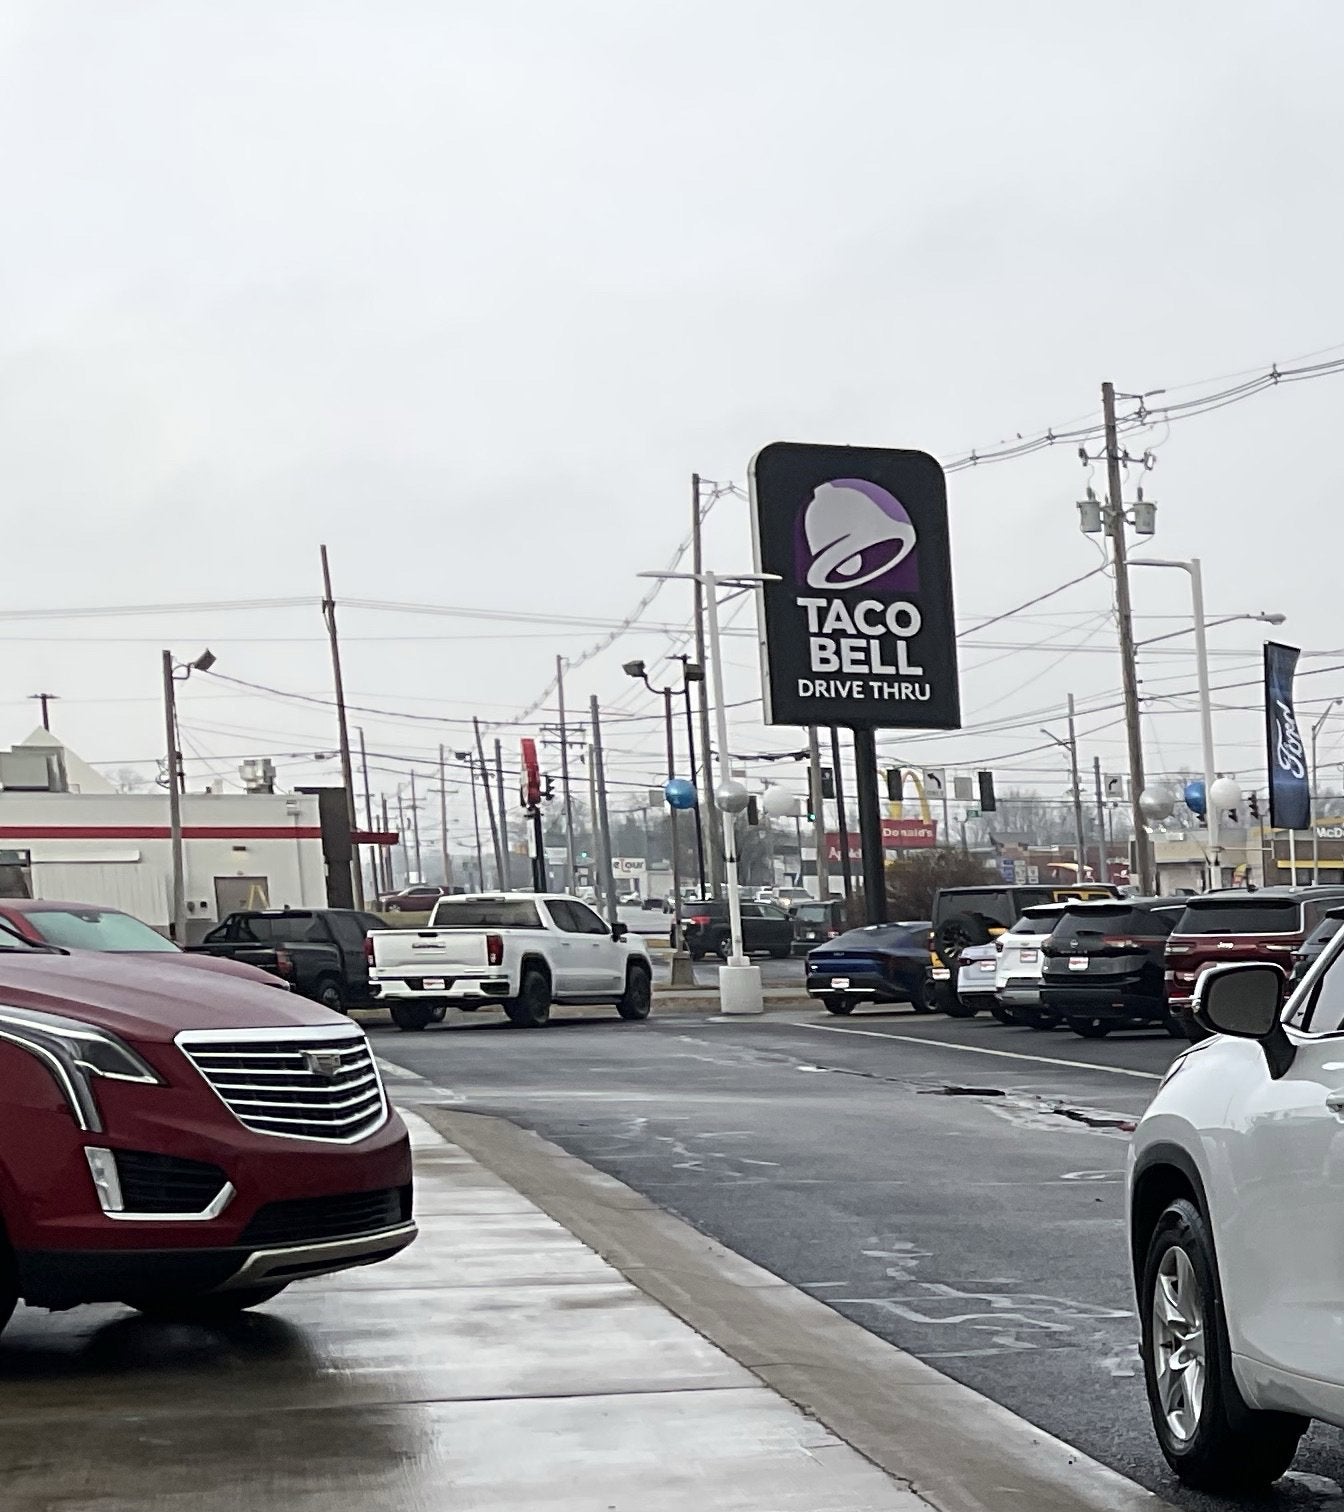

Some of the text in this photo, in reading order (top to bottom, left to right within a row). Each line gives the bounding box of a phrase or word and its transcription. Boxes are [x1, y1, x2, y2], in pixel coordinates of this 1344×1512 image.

[797, 597, 922, 637] TACO
[810, 636, 924, 676] BELL
[798, 679, 931, 701] DRIVE THRU
[1275, 699, 1305, 779] Ford
[882, 827, 933, 838] Donald's
